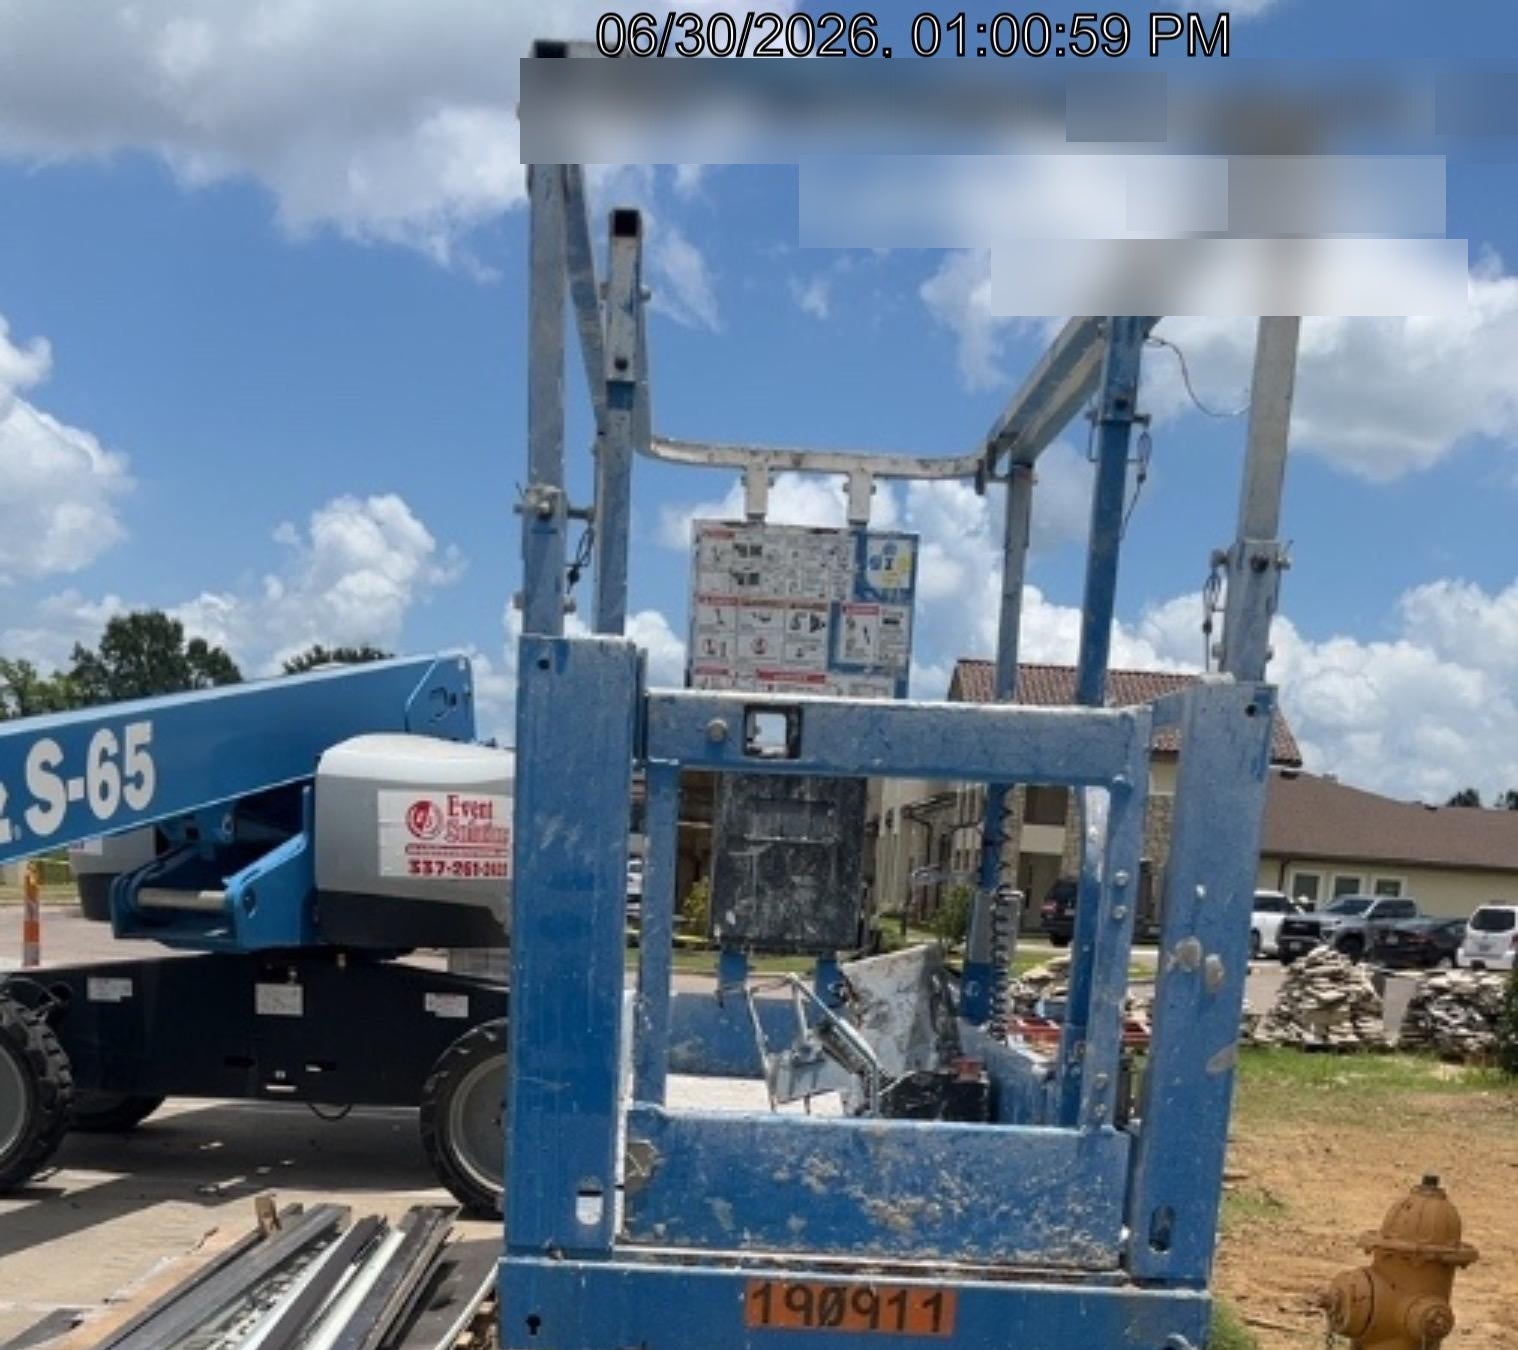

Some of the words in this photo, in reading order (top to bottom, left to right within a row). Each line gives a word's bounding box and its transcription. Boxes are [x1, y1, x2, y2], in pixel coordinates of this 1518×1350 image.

[25, 720, 155, 836] S-65
[446, 794, 493, 820] Event
[752, 1282, 944, 1333] 190911
